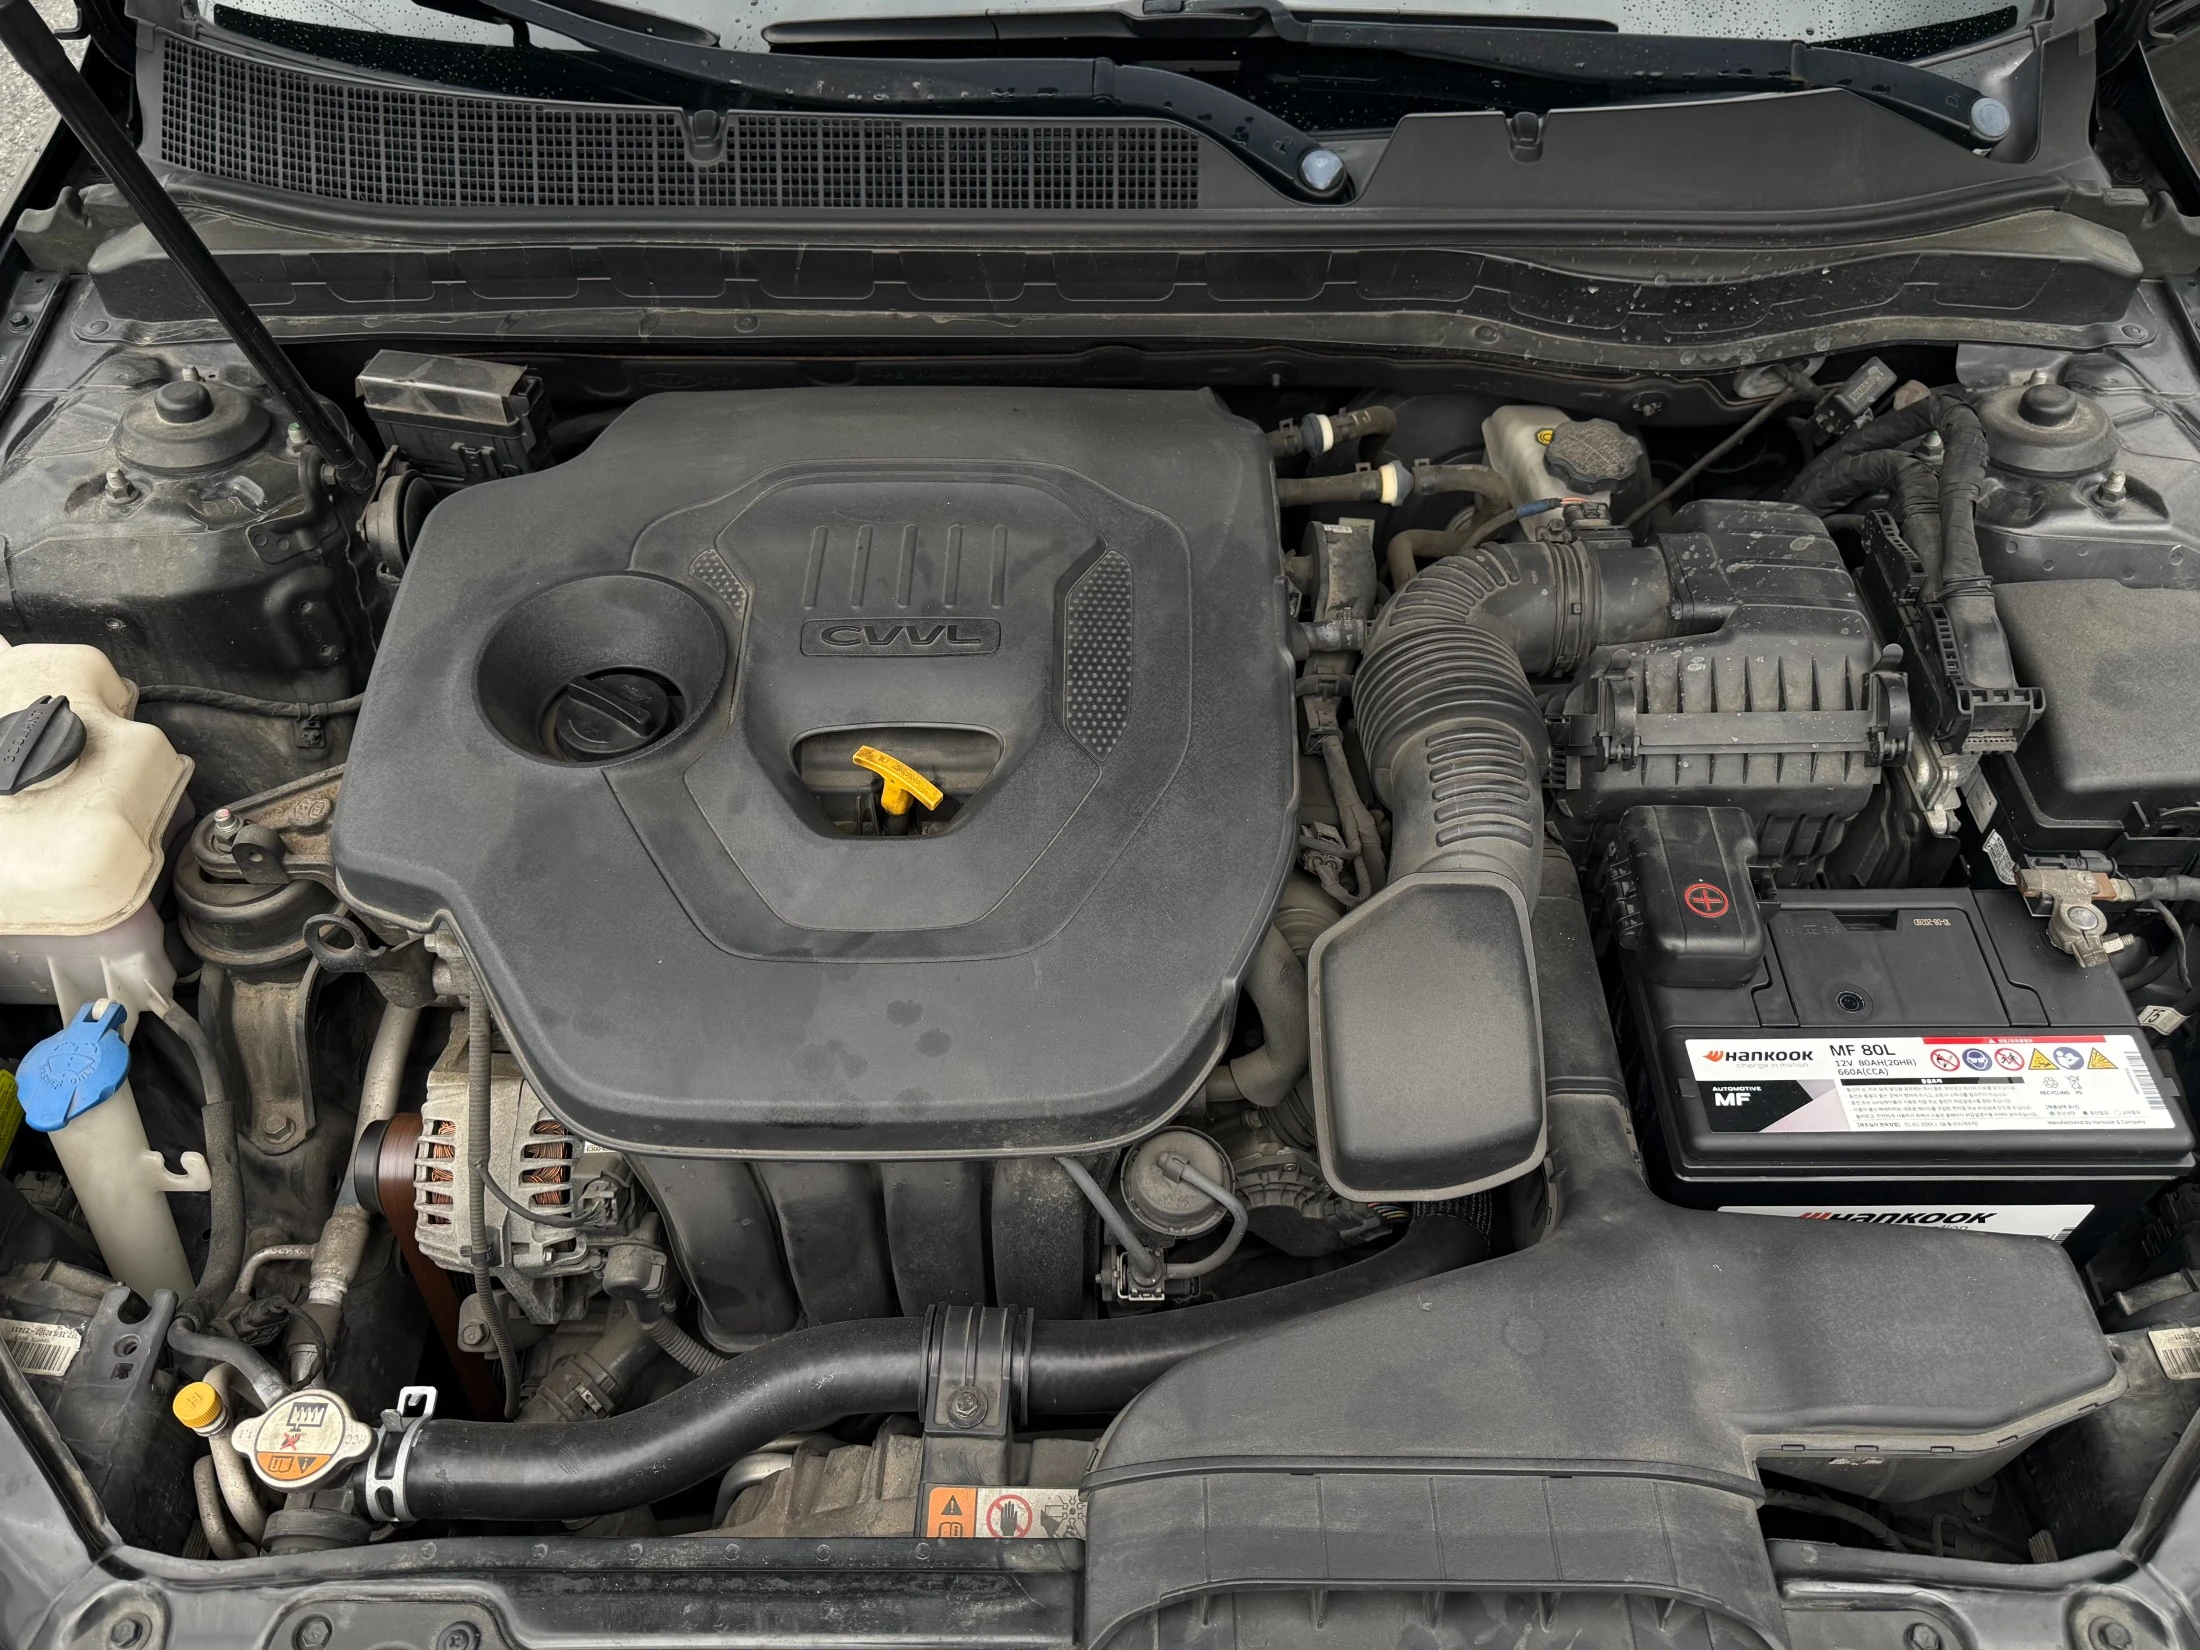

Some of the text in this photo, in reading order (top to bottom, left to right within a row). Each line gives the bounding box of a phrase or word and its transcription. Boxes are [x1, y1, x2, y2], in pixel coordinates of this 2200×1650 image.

[821, 625, 982, 646] CVVL
[3, 709, 44, 764] COOLANT
[2143, 1008, 2166, 1023] T5
[1829, 1044, 1856, 1057] MF
[1861, 1044, 1896, 1056] 80L
[1735, 1061, 1769, 1070] charge
[1834, 1058, 1917, 1068] 12V 80AH(20HR)
[70, 1064, 97, 1085] ONLY
[1837, 1067, 1889, 1077] 660A(CCA)
[1714, 1093, 1752, 1106] MF
[185, 1391, 203, 1408] H
